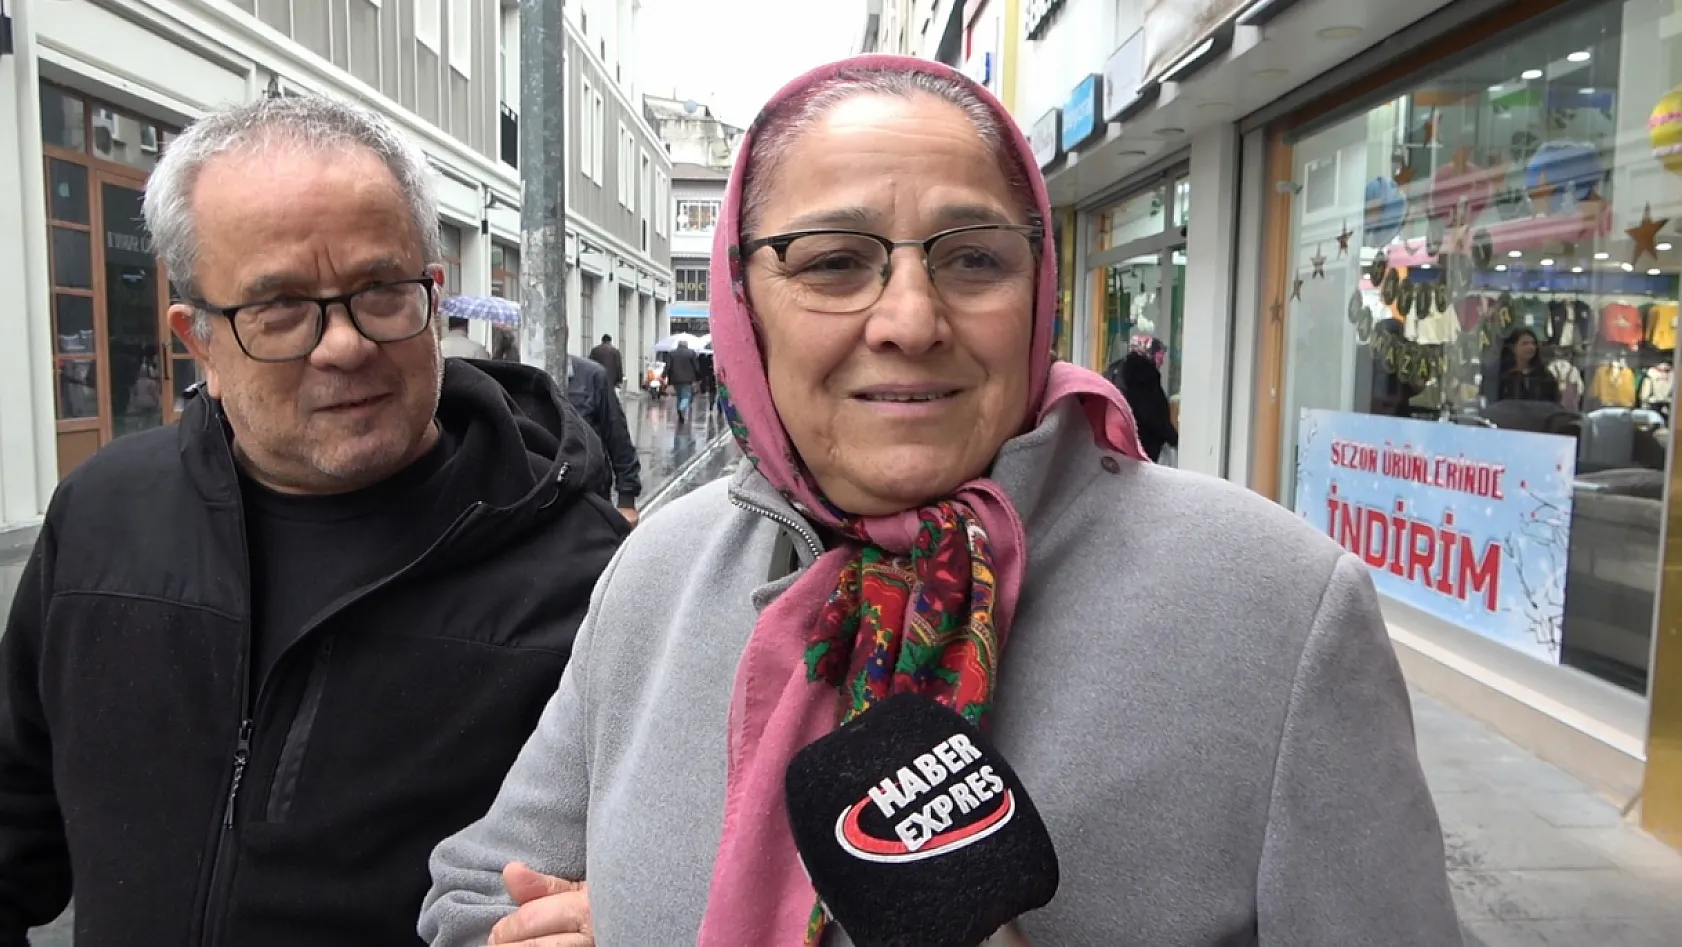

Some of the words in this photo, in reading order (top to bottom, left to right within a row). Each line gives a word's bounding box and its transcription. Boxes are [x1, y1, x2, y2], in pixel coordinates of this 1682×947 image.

[1331, 440, 1378, 473] SEZON
[1382, 440, 1505, 500] ÜRÜNLERİNDE
[1327, 484, 1502, 612] İNDİRİM
[867, 733, 983, 818] HABER
[895, 765, 1004, 851] EXPRES
